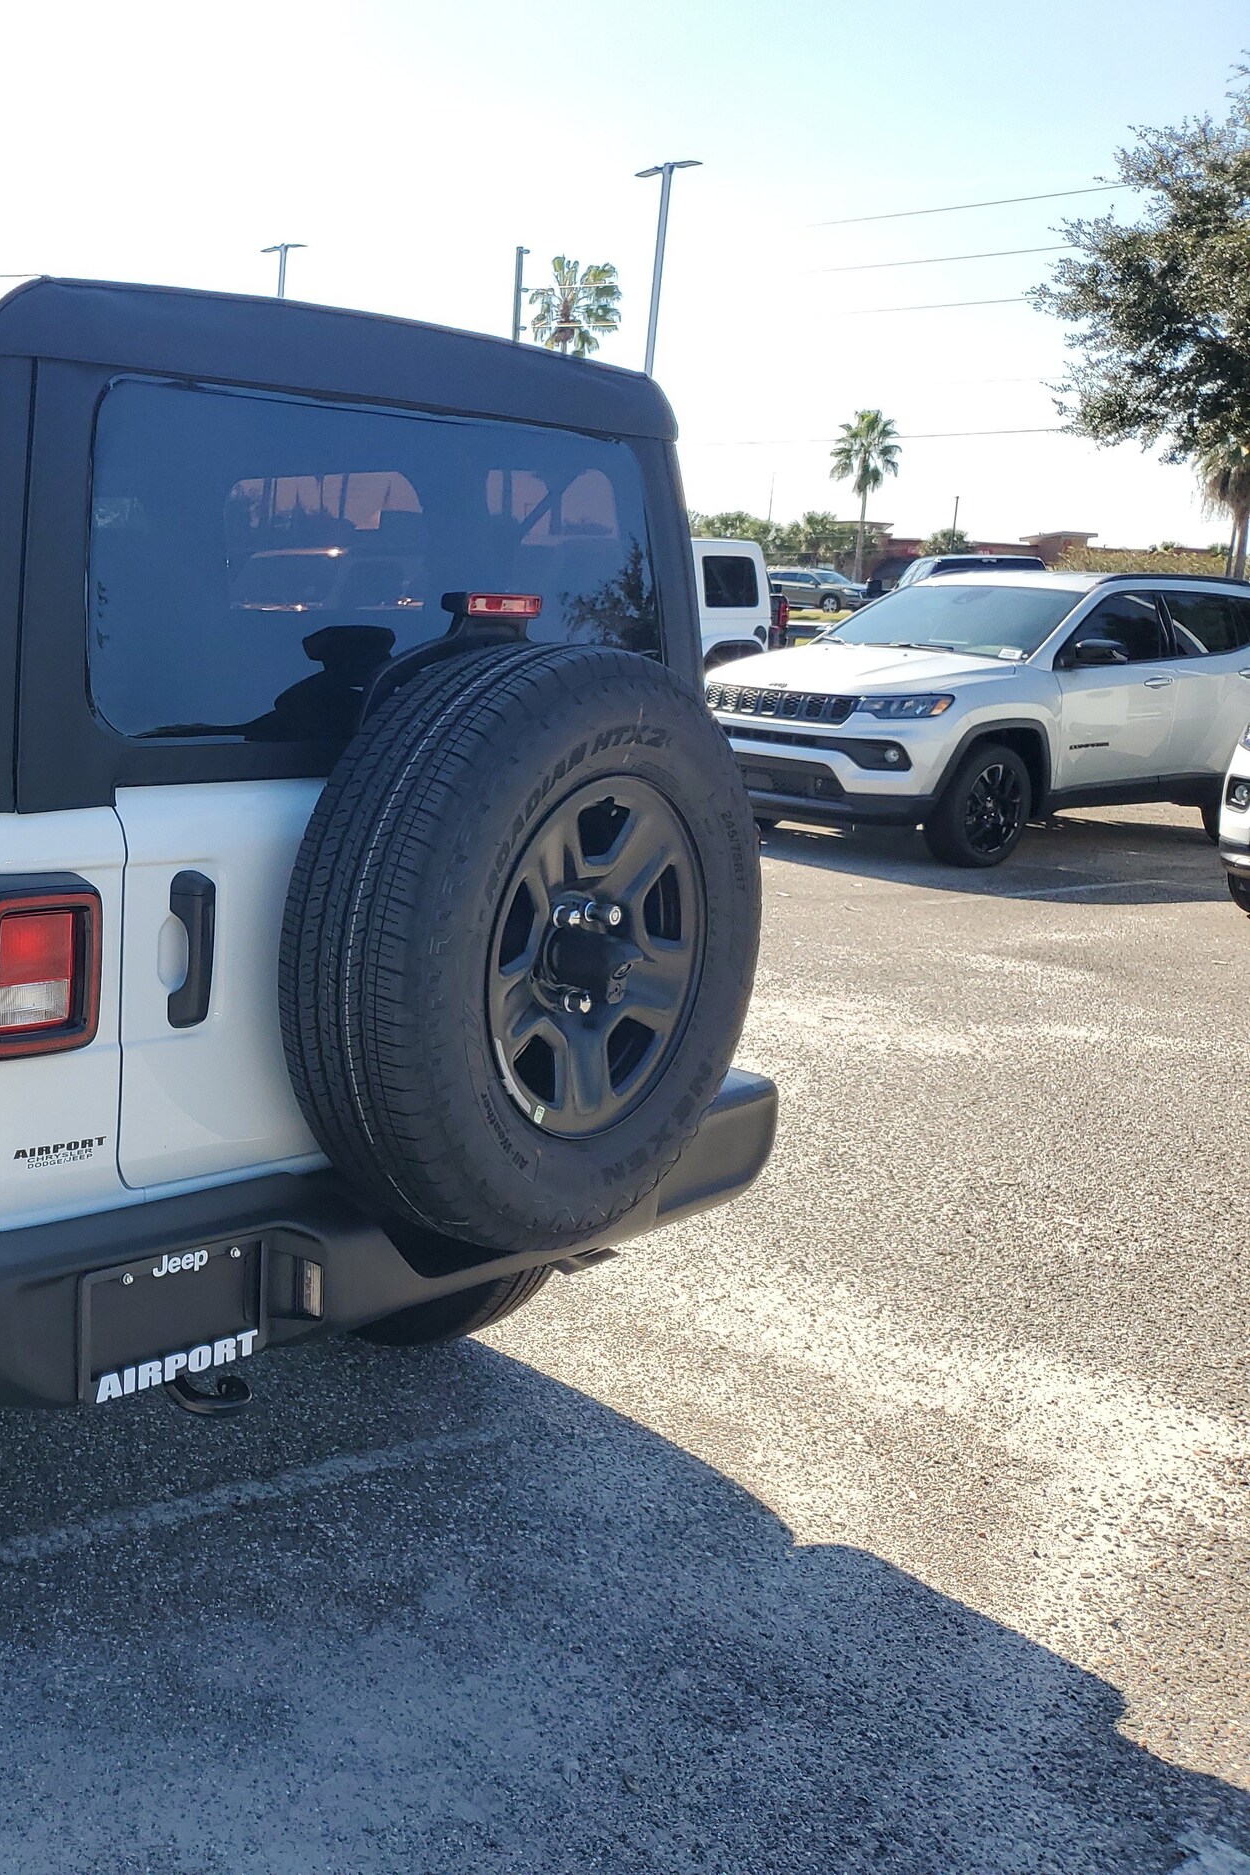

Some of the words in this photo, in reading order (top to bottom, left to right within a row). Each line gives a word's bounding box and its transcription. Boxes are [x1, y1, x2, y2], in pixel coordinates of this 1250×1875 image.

[14, 1136, 107, 1159] AIRPORT
[27, 1148, 93, 1163] CHRYSLER
[27, 1154, 93, 1169] DODGE/JEEP
[152, 1249, 209, 1278] Jeep
[96, 1329, 258, 1404] AIRPORT
